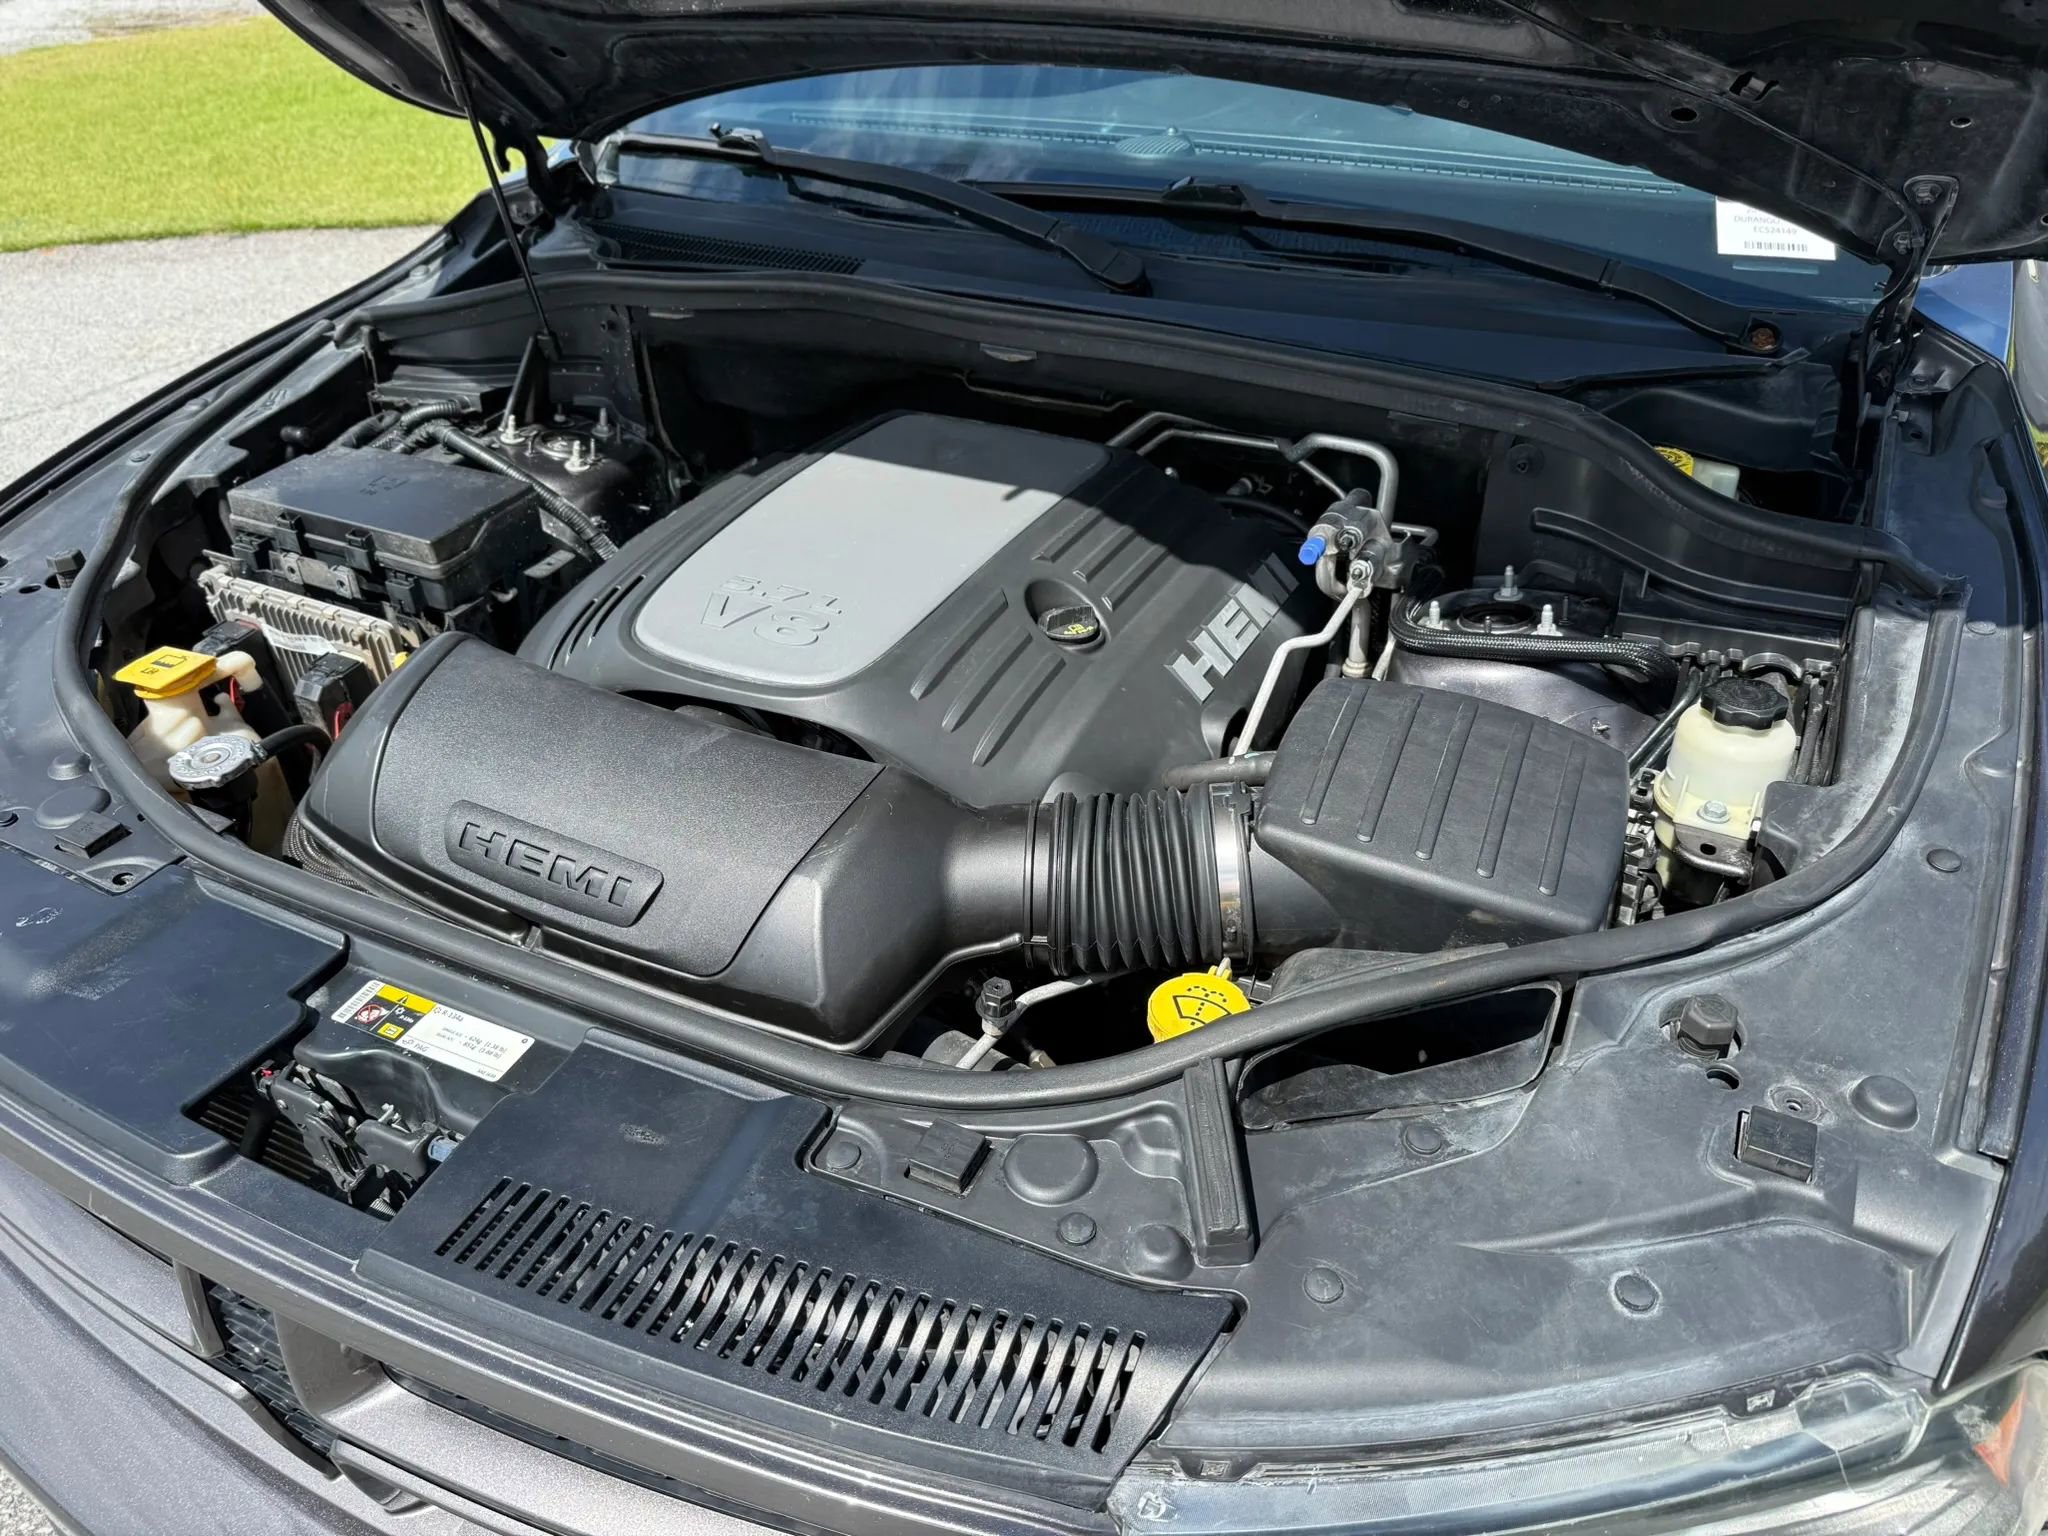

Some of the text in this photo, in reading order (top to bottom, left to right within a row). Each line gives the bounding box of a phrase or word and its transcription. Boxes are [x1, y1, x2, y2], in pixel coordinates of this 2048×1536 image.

[701, 591, 830, 646] V8
[1164, 552, 1300, 704] HEMI
[459, 821, 633, 907] HEMI
